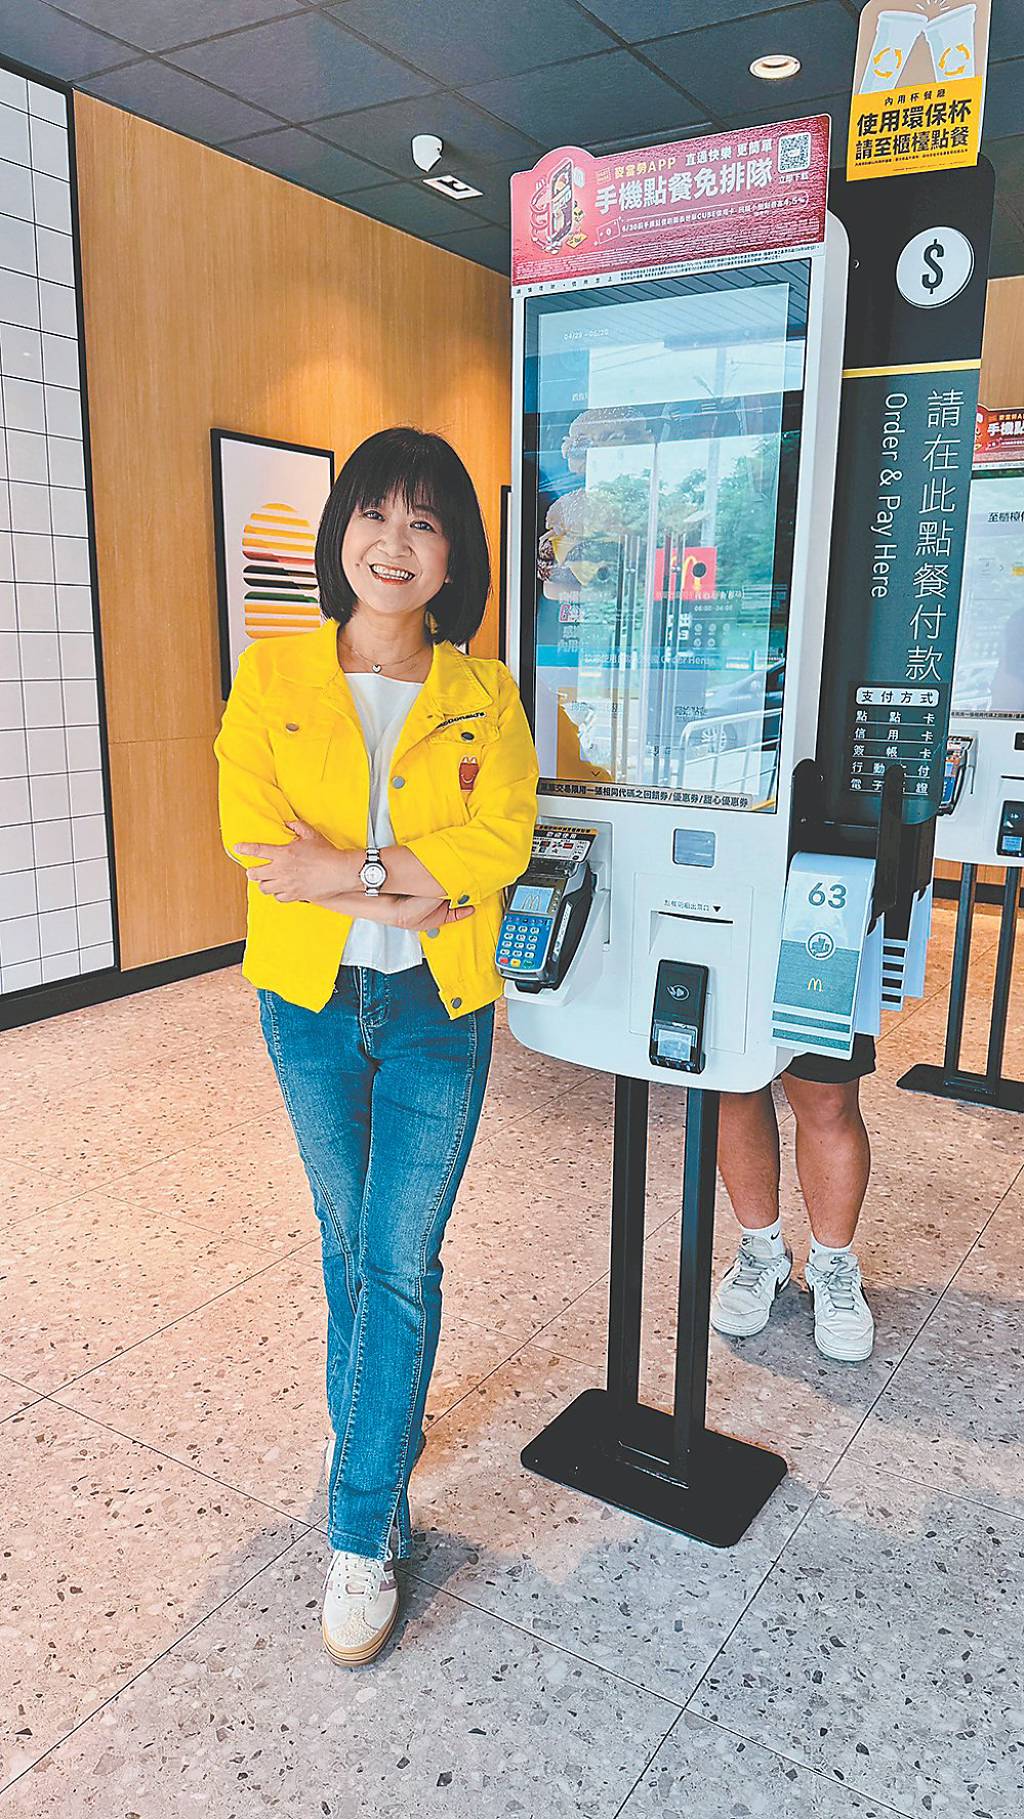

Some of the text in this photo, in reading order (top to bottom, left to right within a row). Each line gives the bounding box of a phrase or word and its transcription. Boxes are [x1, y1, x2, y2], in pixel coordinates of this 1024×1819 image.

[857, 98, 972, 137] 使用環保杯
[855, 126, 969, 161] 請至櫃檯點餐
[594, 157, 773, 215] 手機點餐免排隊
[870, 392, 908, 598] Order & Pay Here
[905, 388, 965, 681] 請在此點餐付款
[861, 690, 934, 704] 支付方式
[856, 710, 935, 724] 點點卡
[854, 728, 934, 742] 信用卡
[851, 761, 930, 777] 行動付
[850, 778, 928, 793] 電子證
[808, 882, 847, 909] 63
